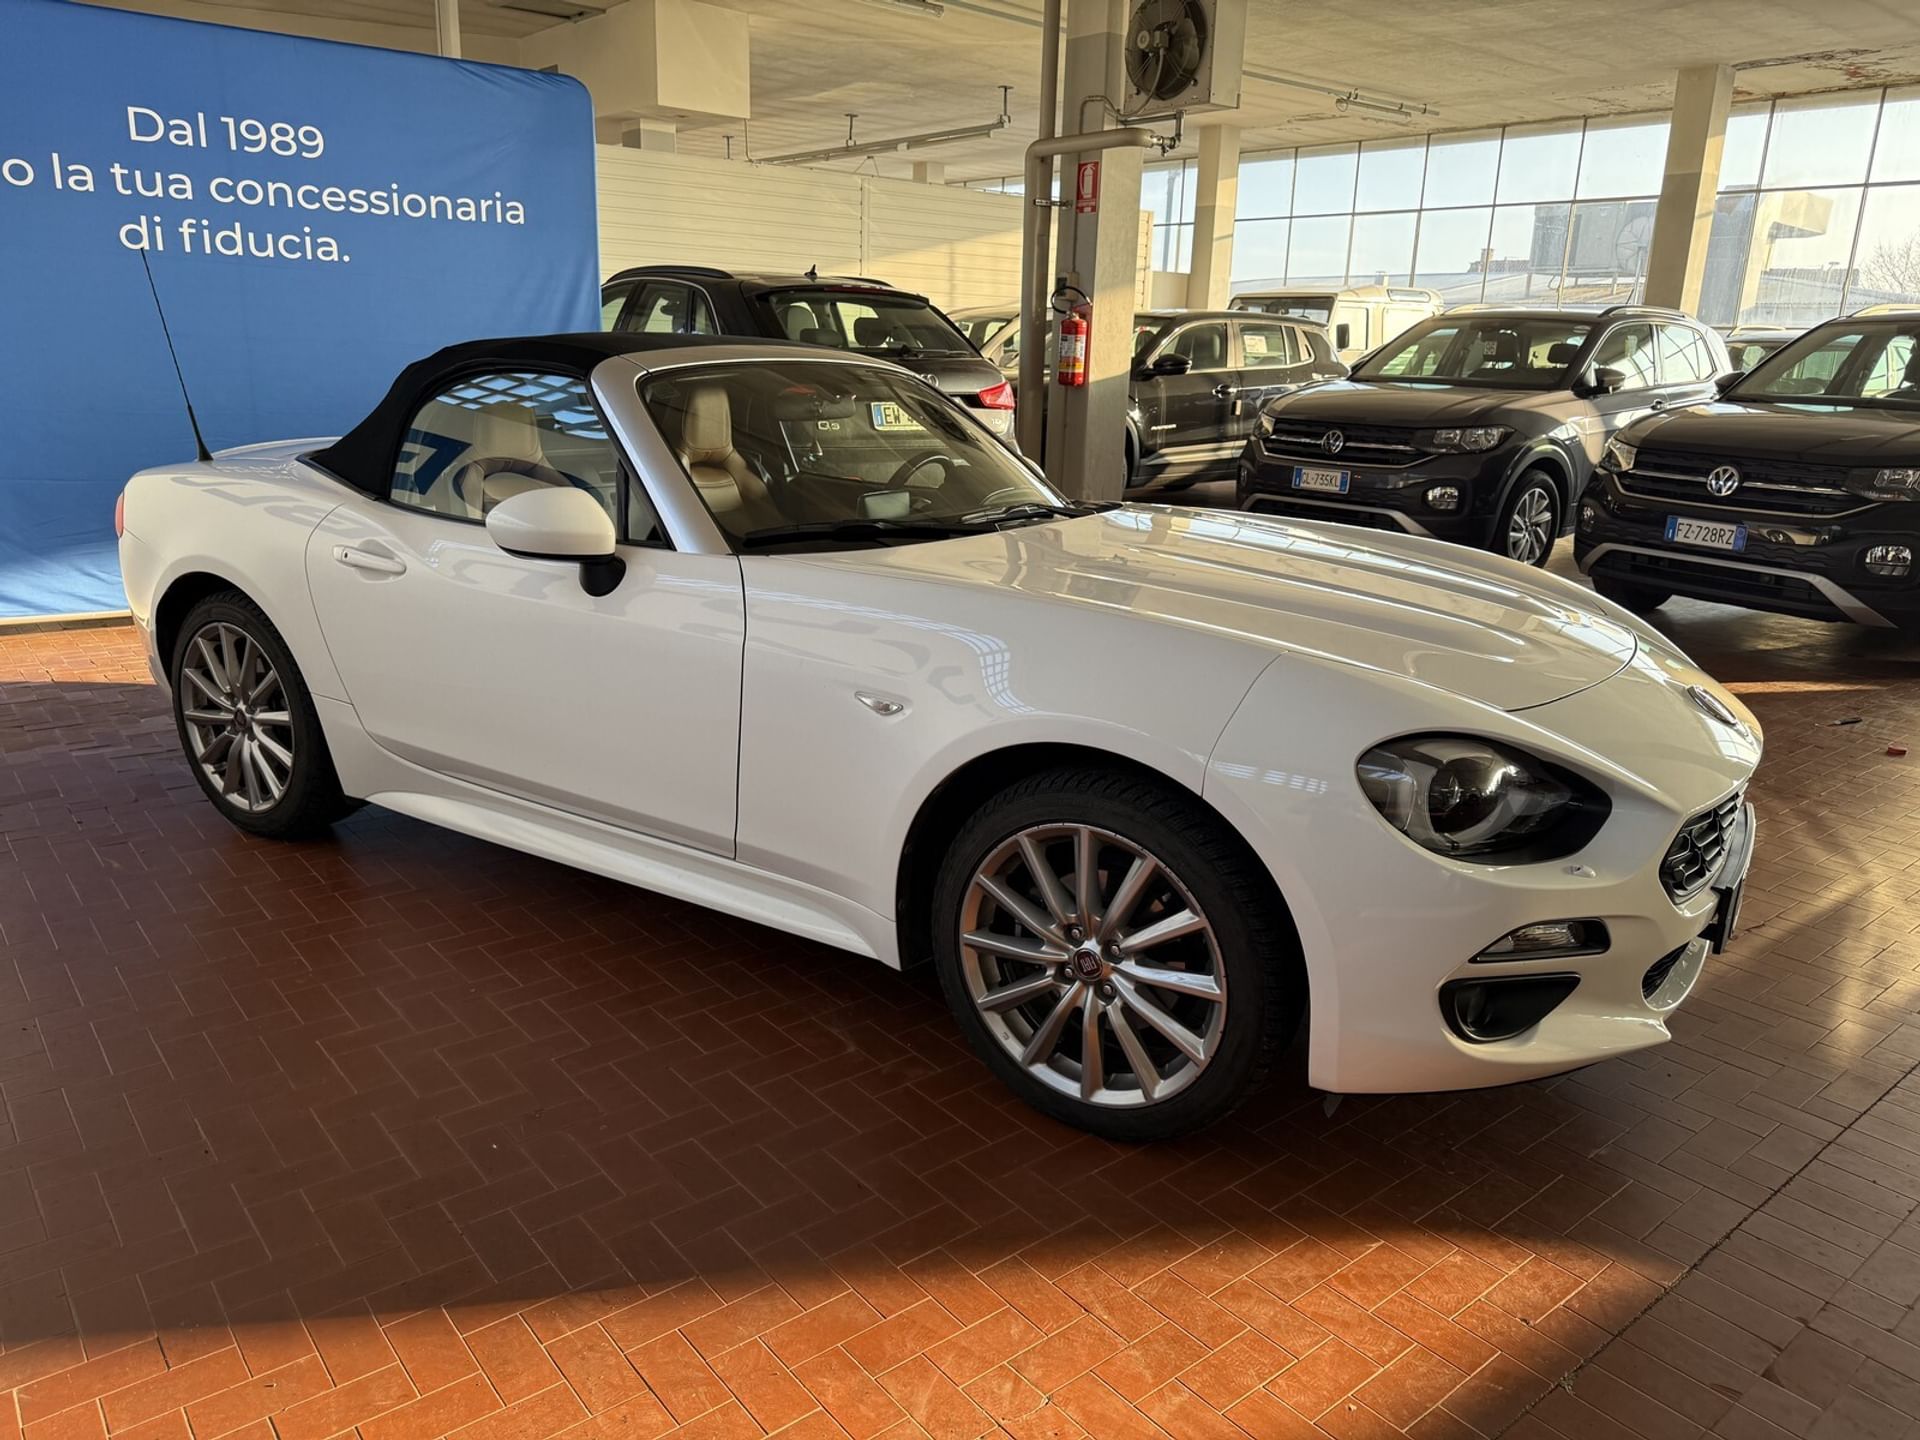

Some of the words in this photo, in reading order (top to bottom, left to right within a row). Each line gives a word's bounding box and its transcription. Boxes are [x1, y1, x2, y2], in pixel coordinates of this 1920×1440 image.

[127, 106, 208, 149] Dal
[220, 116, 325, 159] 1989
[51, 152, 95, 192] la
[109, 162, 193, 200] tua
[209, 177, 526, 225] concessionaria
[119, 215, 165, 251] di
[178, 218, 351, 263] fiducia.
